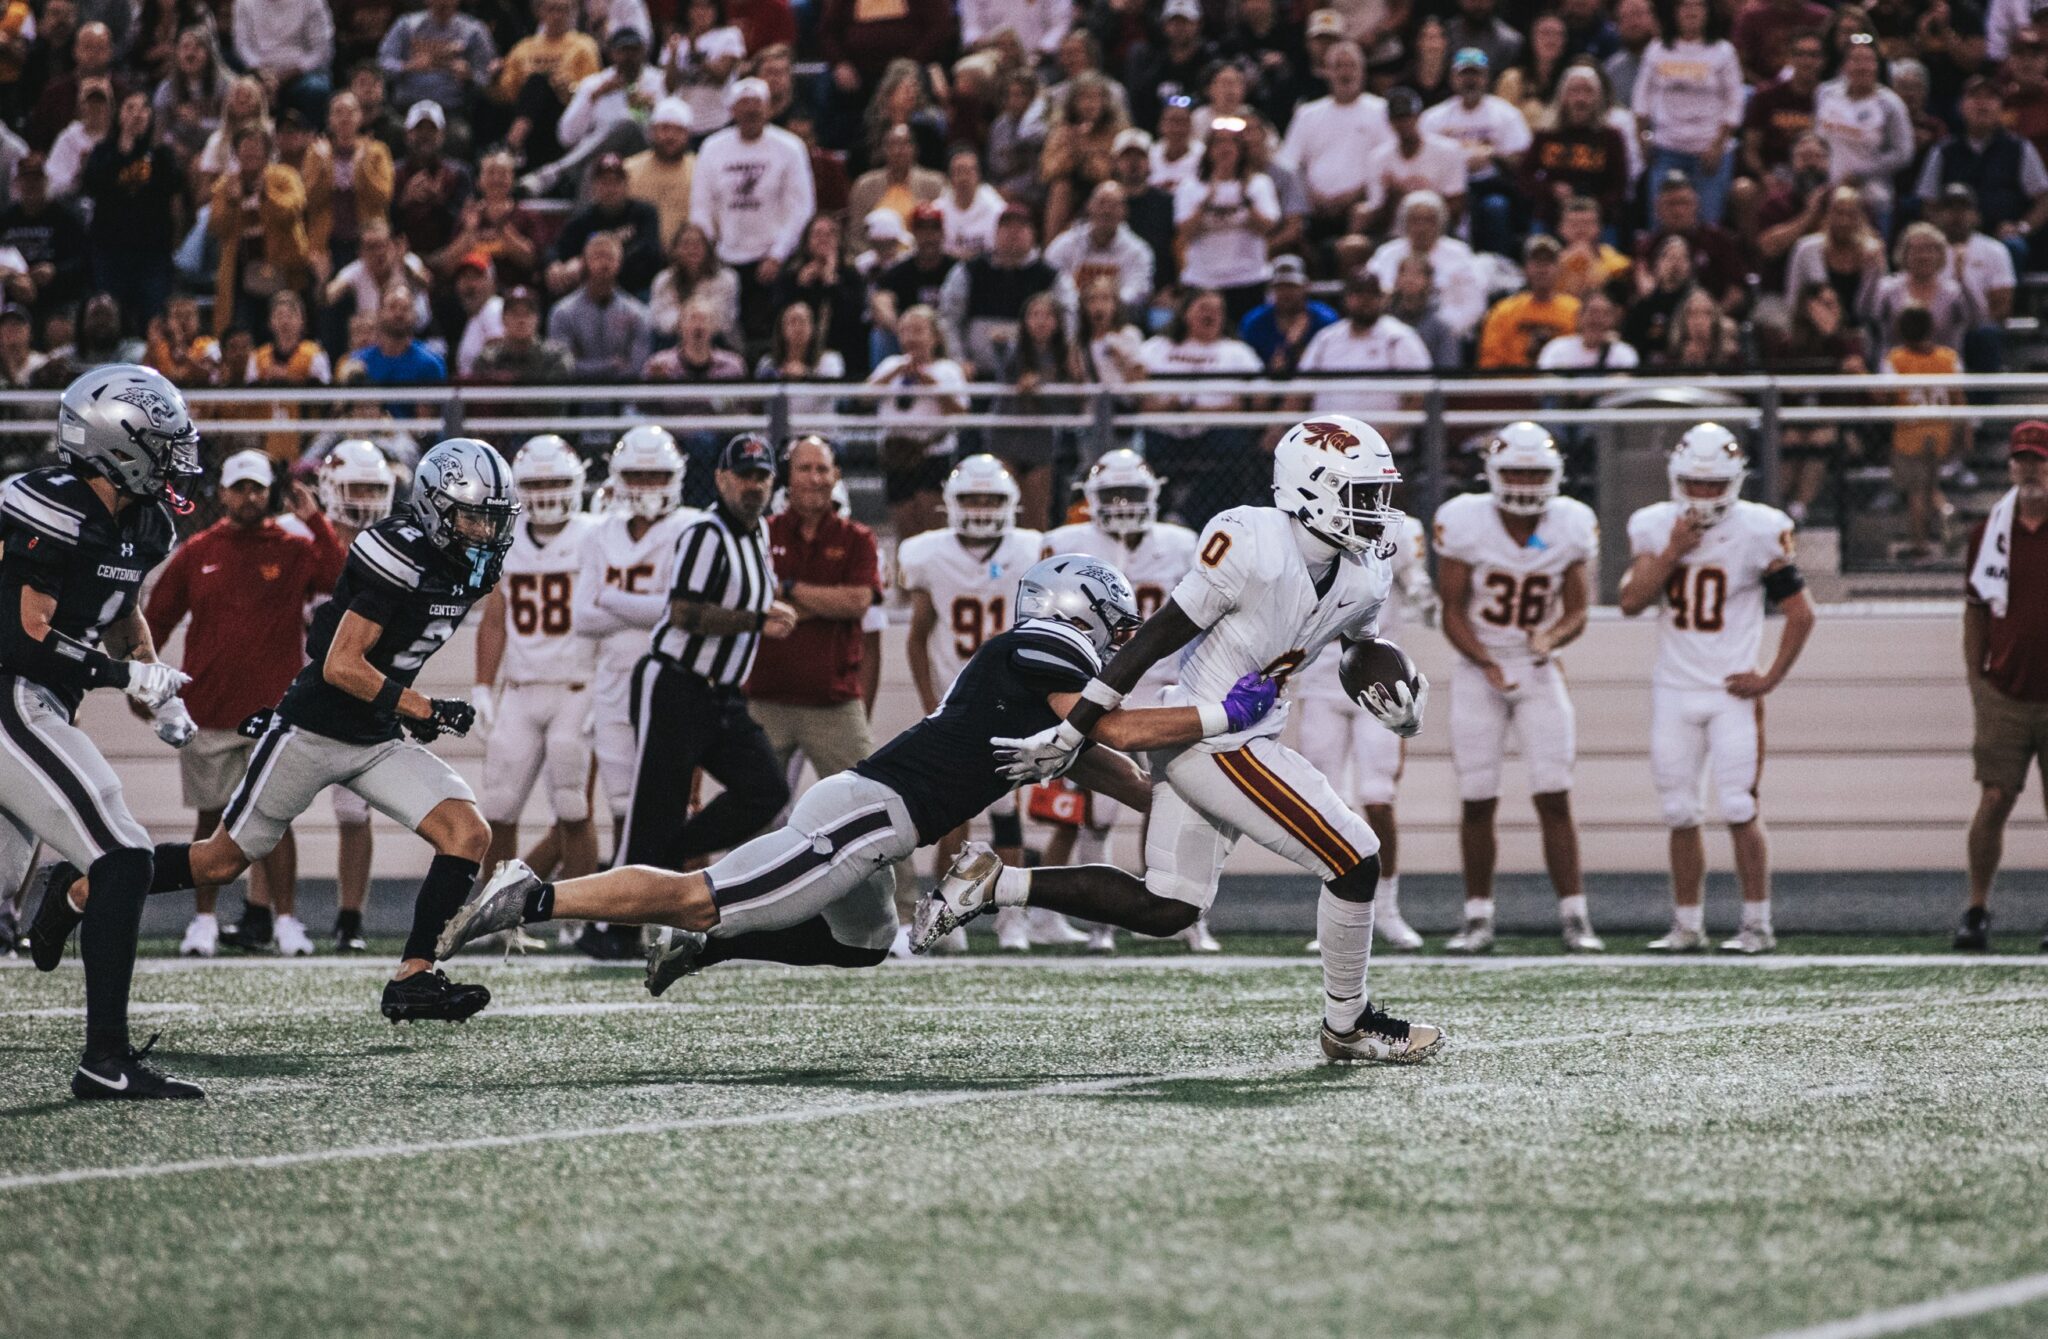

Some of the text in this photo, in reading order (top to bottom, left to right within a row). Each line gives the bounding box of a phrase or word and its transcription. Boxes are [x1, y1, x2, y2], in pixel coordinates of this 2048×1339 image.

[46, 473, 78, 488] 1
[396, 525, 424, 543] 2
[1200, 529, 1235, 569] 0
[79, 590, 126, 649] 1
[508, 570, 572, 637] 68
[1481, 571, 1551, 628] 36
[1667, 565, 1726, 632] 40
[391, 619, 455, 671] 2
[951, 596, 1007, 660] 91
[1052, 793, 1074, 818] G
